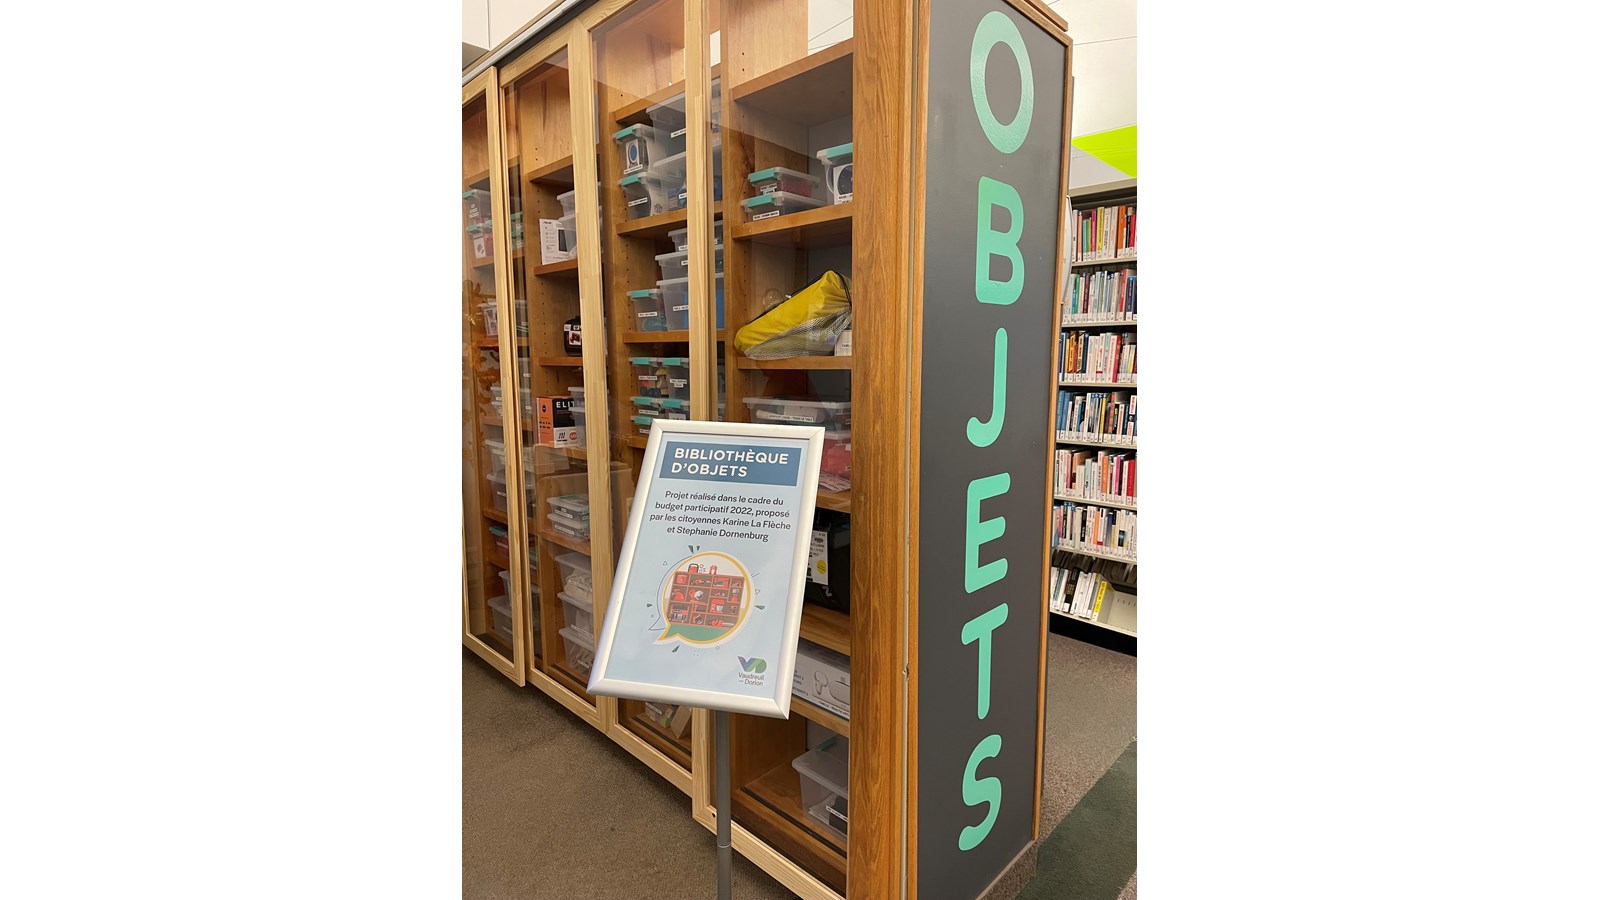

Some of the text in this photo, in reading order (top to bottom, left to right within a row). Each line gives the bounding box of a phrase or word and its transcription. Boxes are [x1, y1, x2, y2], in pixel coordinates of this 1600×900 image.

[958, 11, 1034, 851] OBJETS
[674, 448, 789, 465] BIBLIOTHÈQUE
[671, 462, 748, 477] D’OBJETS
[665, 490, 784, 506] Projet réalisé dans le cadre du
[655, 501, 790, 519] budget participatif 2022, proposé
[649, 513, 791, 530] par les citoyennes Karine La Flèche
[666, 526, 769, 542] et Stephanie Dornenburg
[738, 672, 764, 680] Vaudreuil
